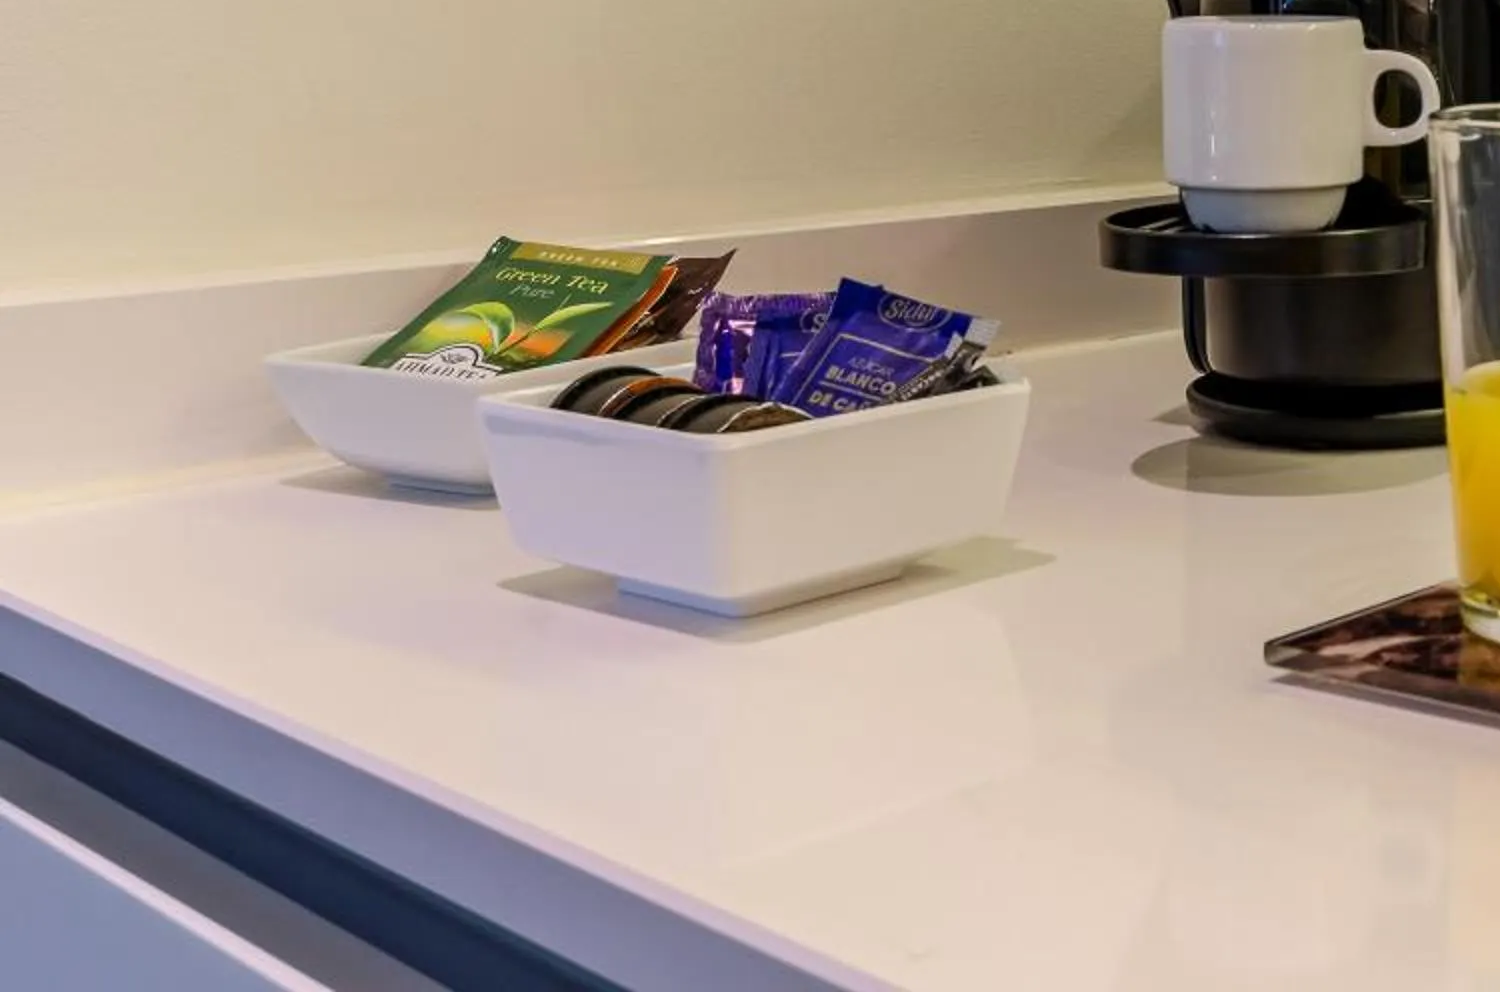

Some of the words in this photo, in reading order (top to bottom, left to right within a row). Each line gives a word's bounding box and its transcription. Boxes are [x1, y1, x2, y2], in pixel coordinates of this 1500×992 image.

[495, 267, 561, 285] Green
[566, 274, 610, 295] Tea
[508, 283, 556, 299] Pure
[824, 364, 897, 395] BLANCO
[806, 390, 834, 407] DE
